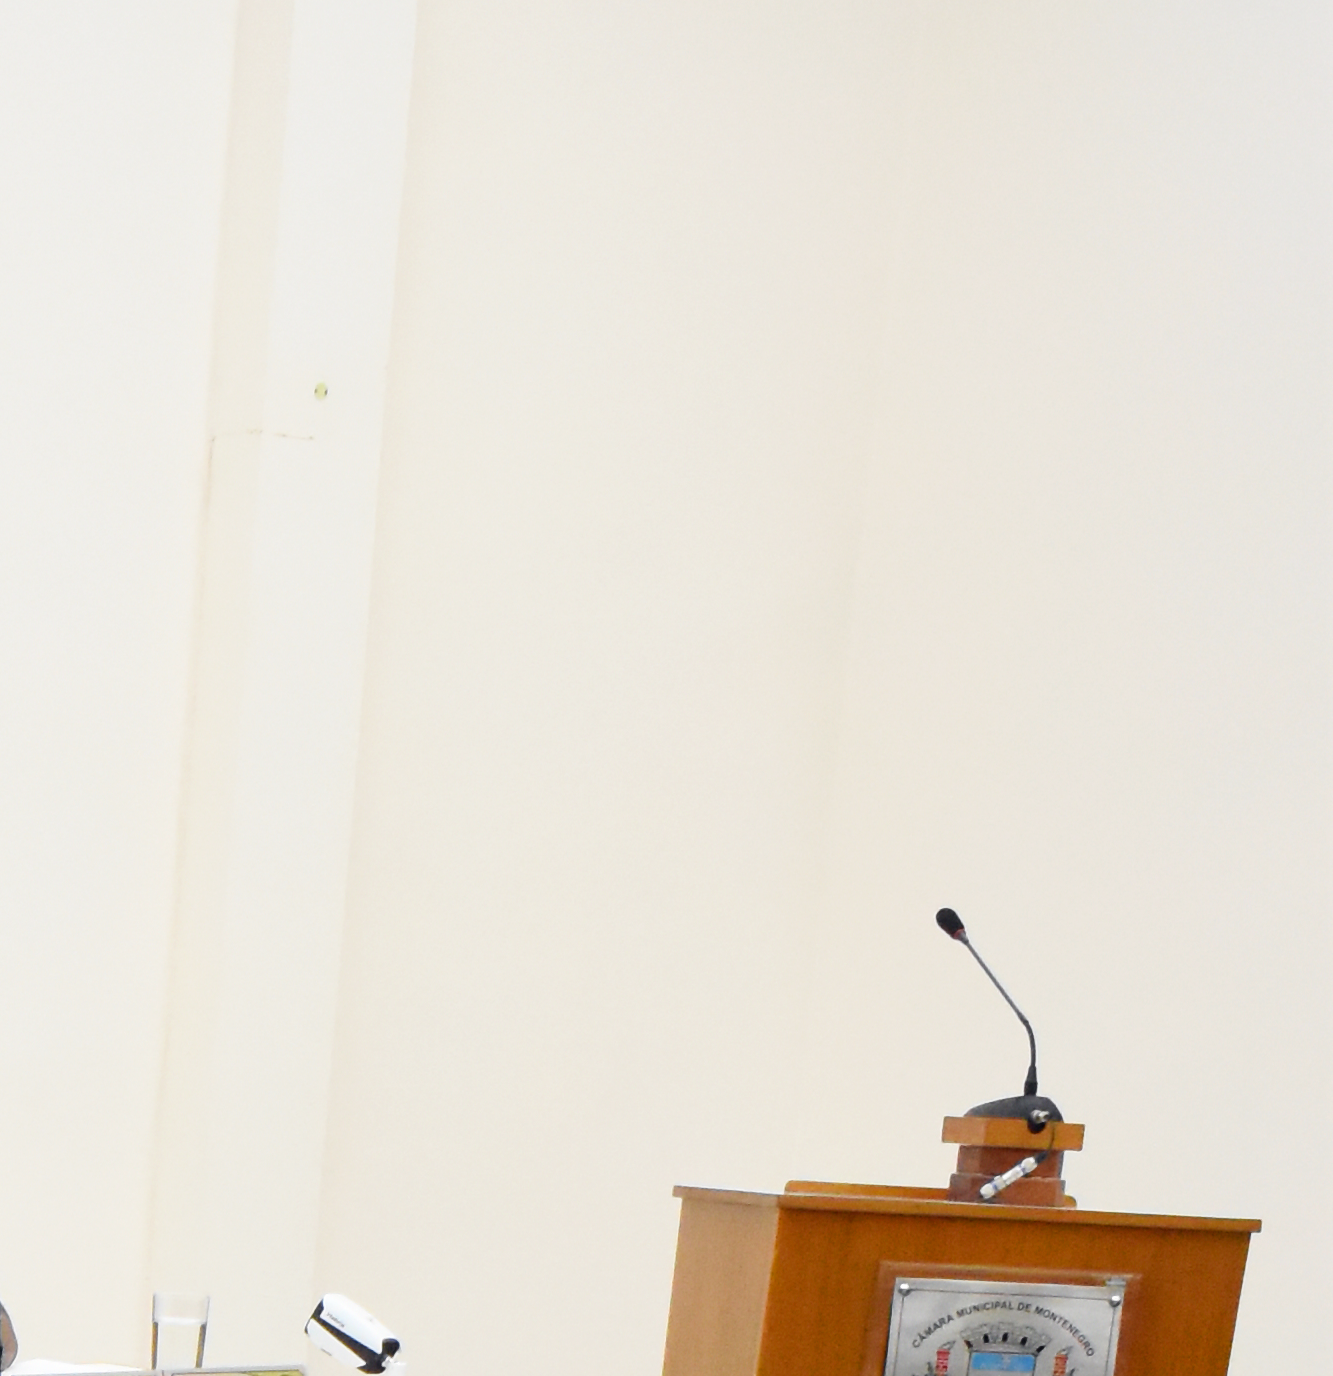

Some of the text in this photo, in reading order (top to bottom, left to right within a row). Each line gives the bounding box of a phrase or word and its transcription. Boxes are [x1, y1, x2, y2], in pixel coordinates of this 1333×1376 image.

[911, 1301, 1095, 1358] CÂMARA MUNICIPAL DE MONTENEGRO
